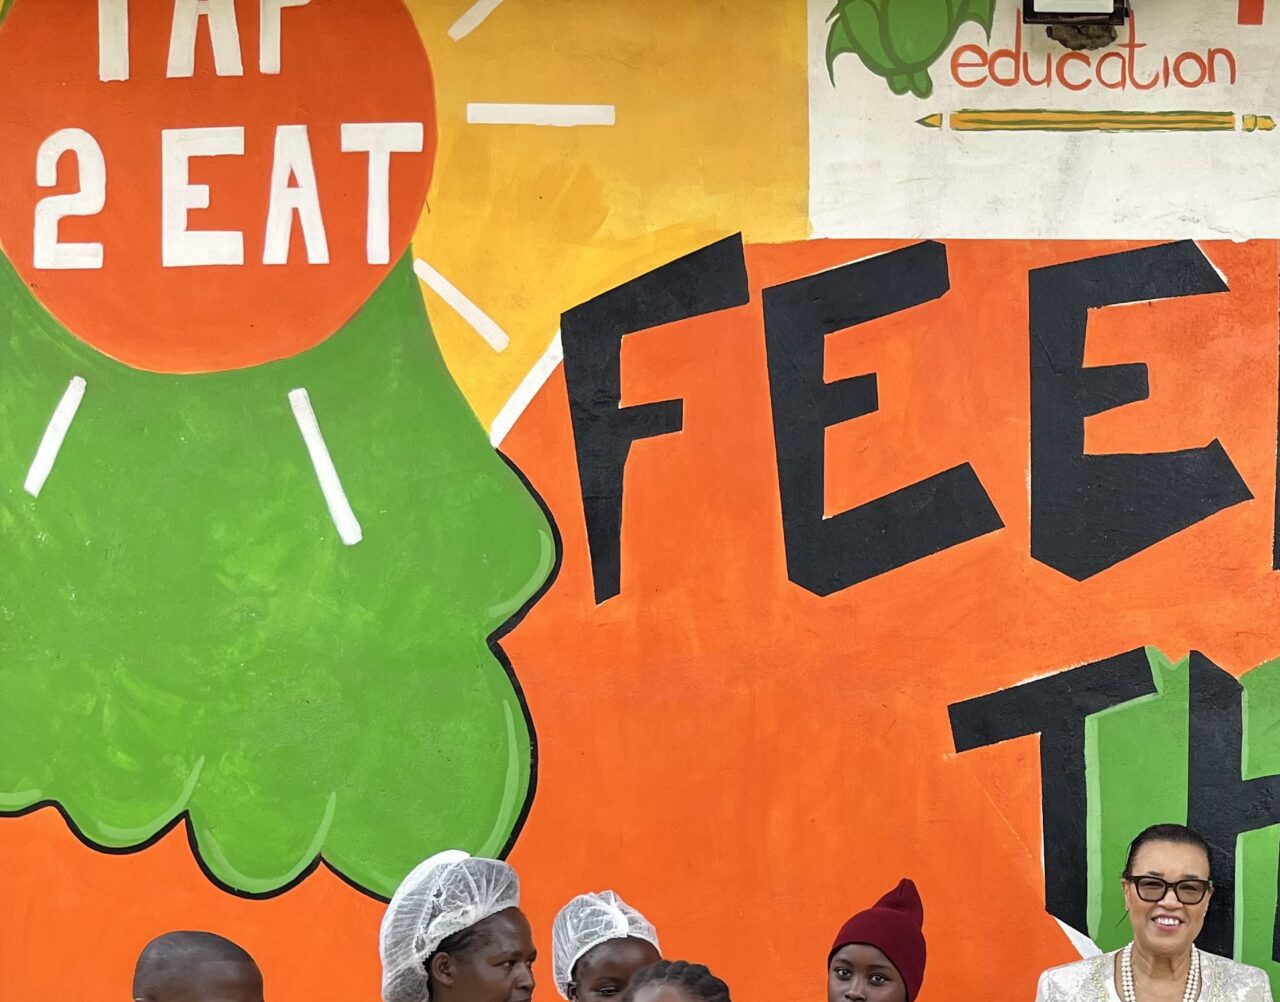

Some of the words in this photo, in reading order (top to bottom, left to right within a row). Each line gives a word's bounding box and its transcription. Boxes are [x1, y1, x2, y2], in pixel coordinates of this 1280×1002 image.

[950, 7, 1237, 92] education
[33, 127, 107, 270] 2
[161, 121, 424, 268] EAT
